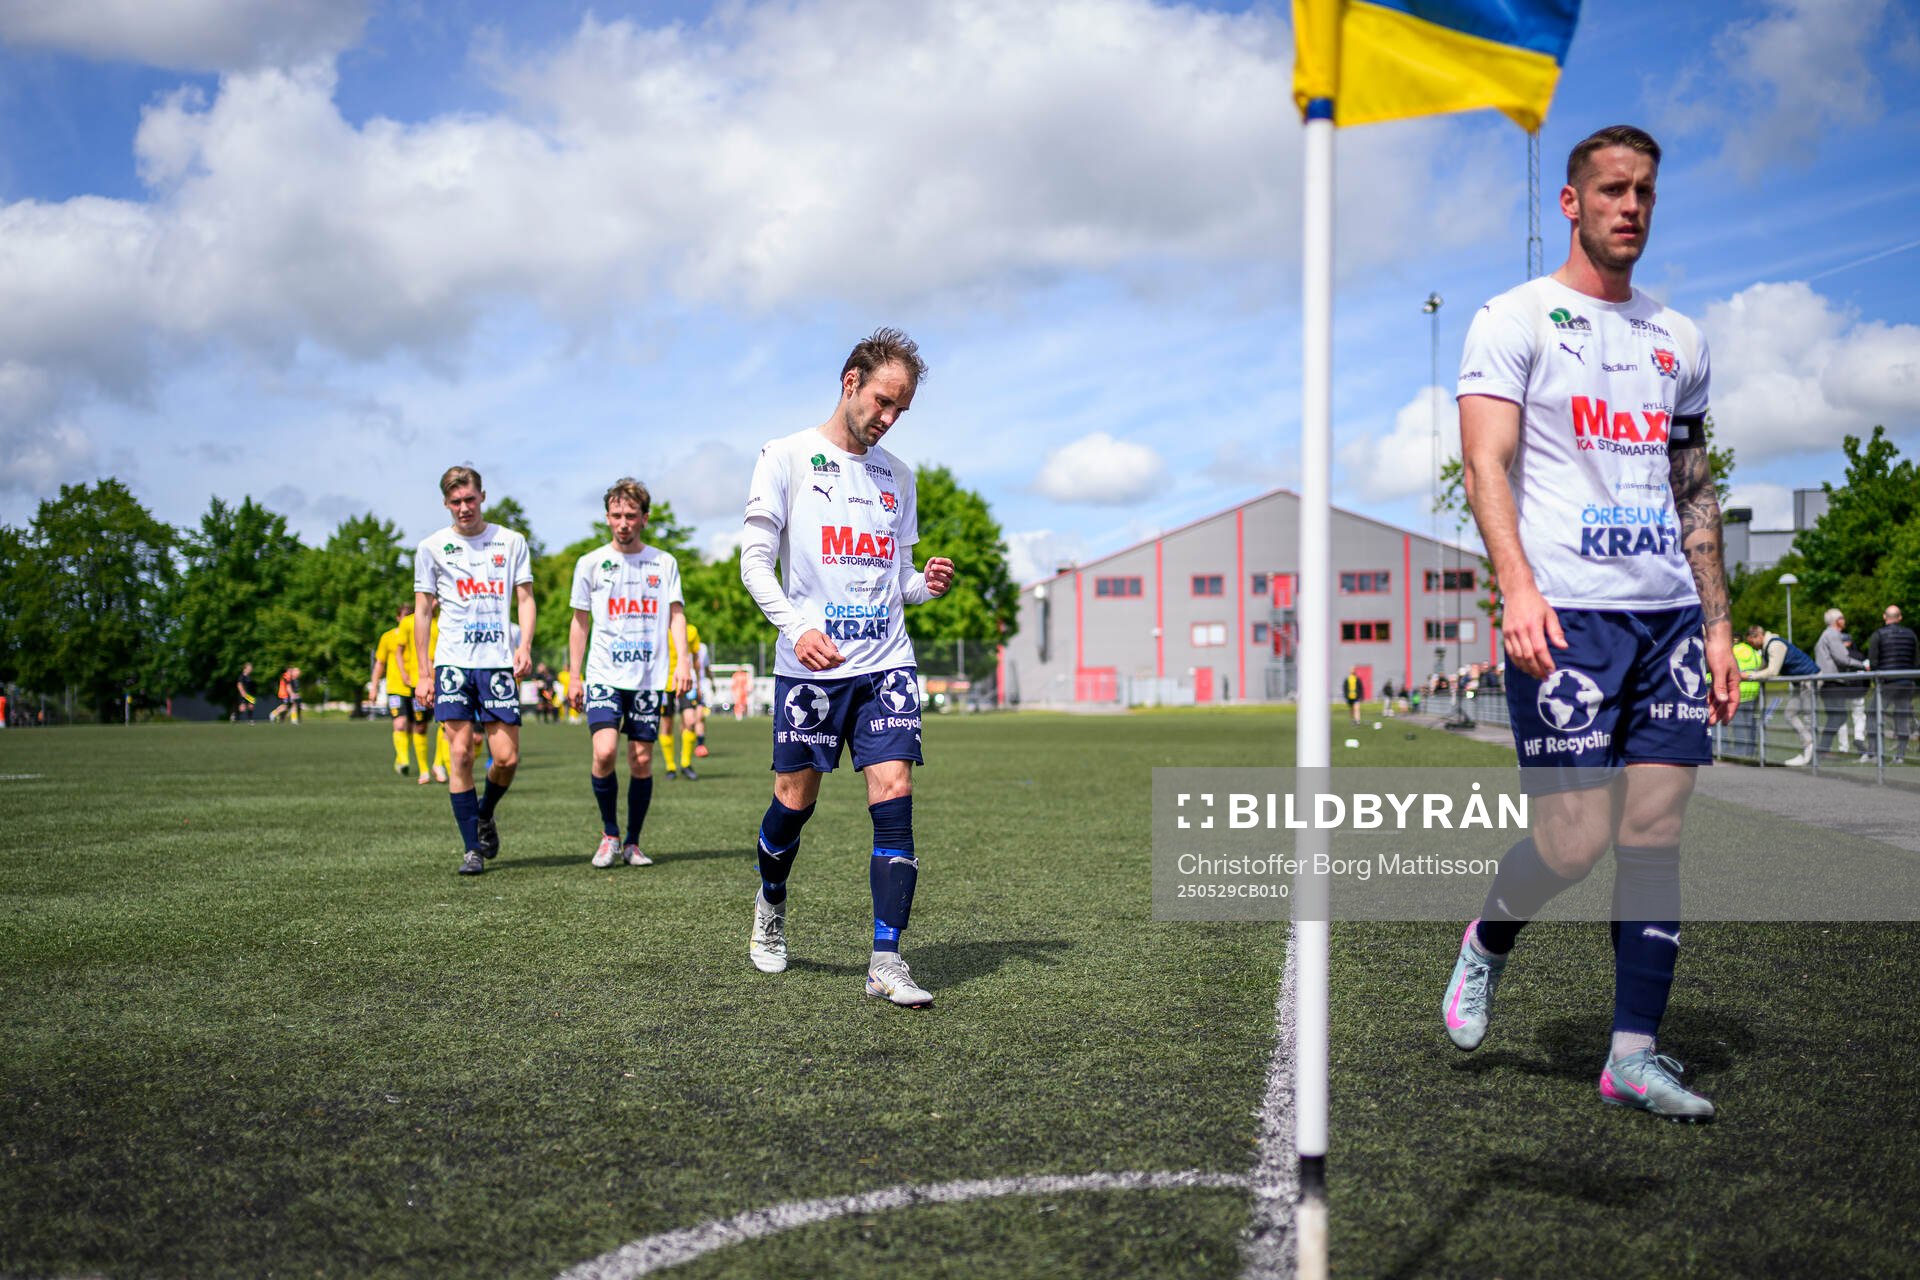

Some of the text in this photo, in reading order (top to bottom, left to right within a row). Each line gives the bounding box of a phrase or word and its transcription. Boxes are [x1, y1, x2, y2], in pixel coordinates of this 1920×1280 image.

[1577, 439, 1595, 450] ICA
[872, 465, 893, 478] STENA
[1582, 504, 1673, 525] ÖRESUN
[822, 526, 895, 560] MAXI
[822, 556, 838, 565] ICA
[456, 578, 504, 598] MAXI
[608, 597, 658, 615] MAXI
[464, 630, 505, 644] KRAFT
[612, 650, 653, 662] KRAFT
[1651, 704, 1673, 719] HF
[870, 718, 885, 732] HF
[778, 731, 837, 748] HF Recycling
[1524, 738, 1542, 756] HF
